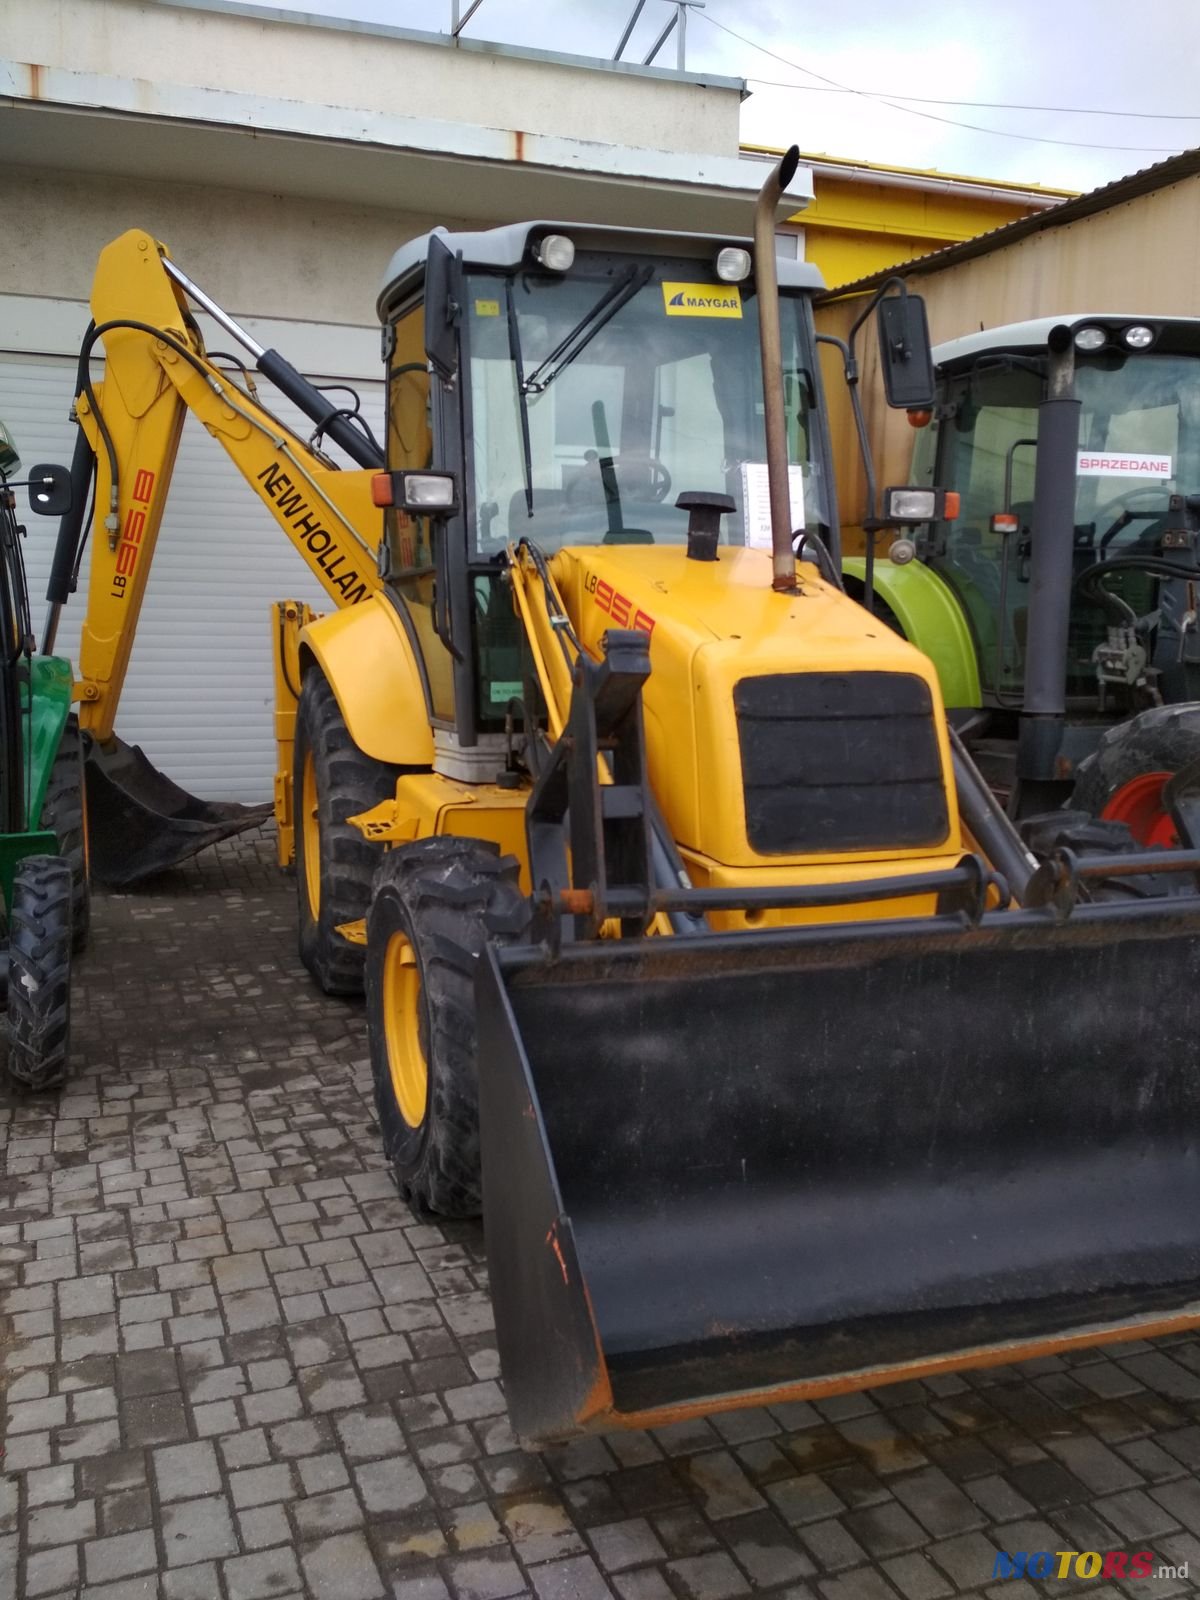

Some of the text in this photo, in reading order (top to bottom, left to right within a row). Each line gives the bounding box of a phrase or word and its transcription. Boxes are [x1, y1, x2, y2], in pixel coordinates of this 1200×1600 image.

[687, 297, 738, 309] MAYGAR
[1079, 458, 1169, 472] SPRZEDANE
[257, 462, 374, 606] NEW HOLLAN
